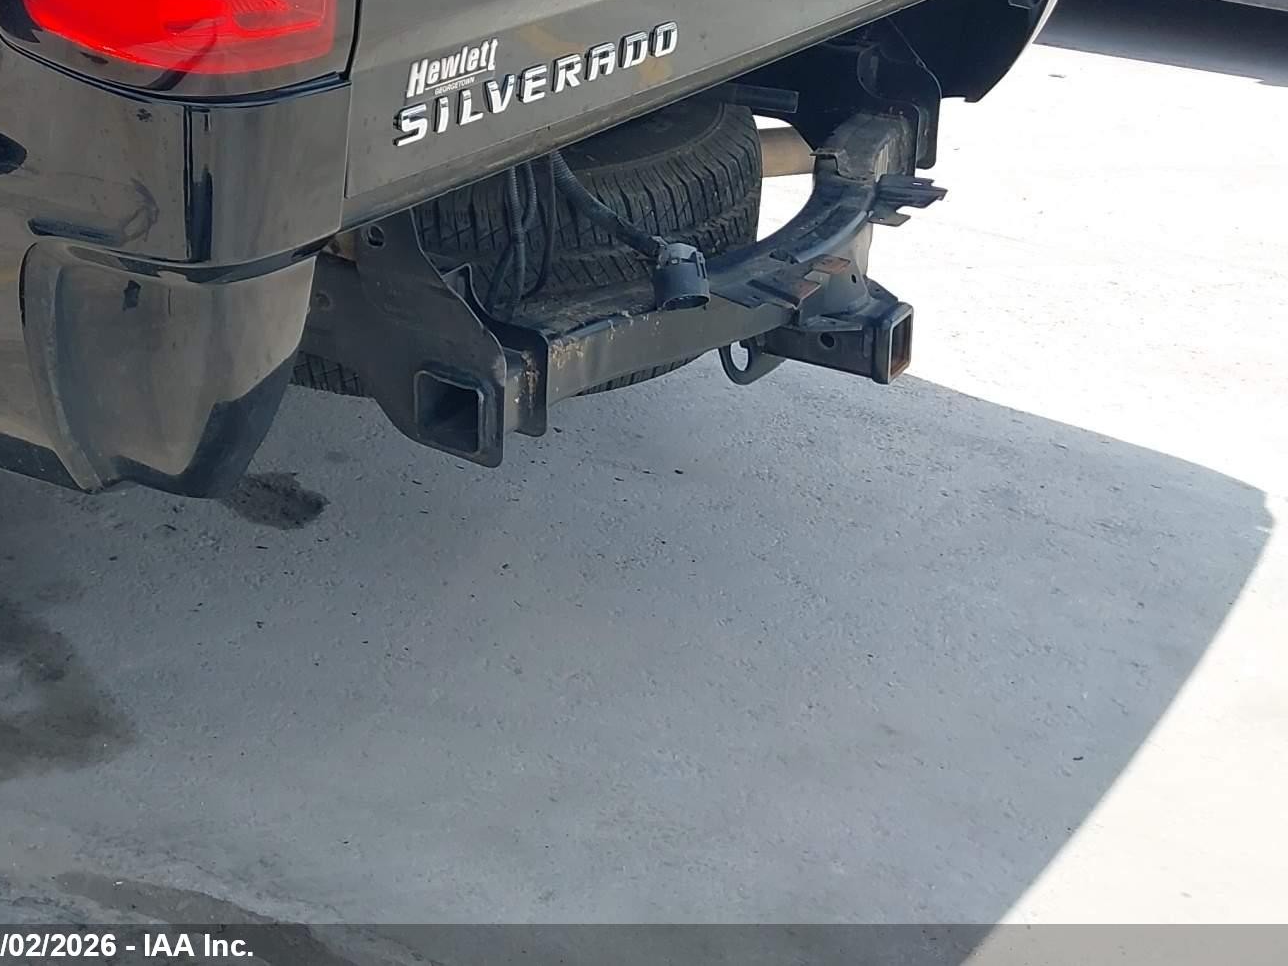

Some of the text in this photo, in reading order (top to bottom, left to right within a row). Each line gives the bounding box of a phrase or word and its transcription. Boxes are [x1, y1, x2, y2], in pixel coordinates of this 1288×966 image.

[393, 20, 679, 147] SILVERADO
[406, 38, 498, 98] Hewlett
[434, 76, 476, 96] GEORGETOWN
